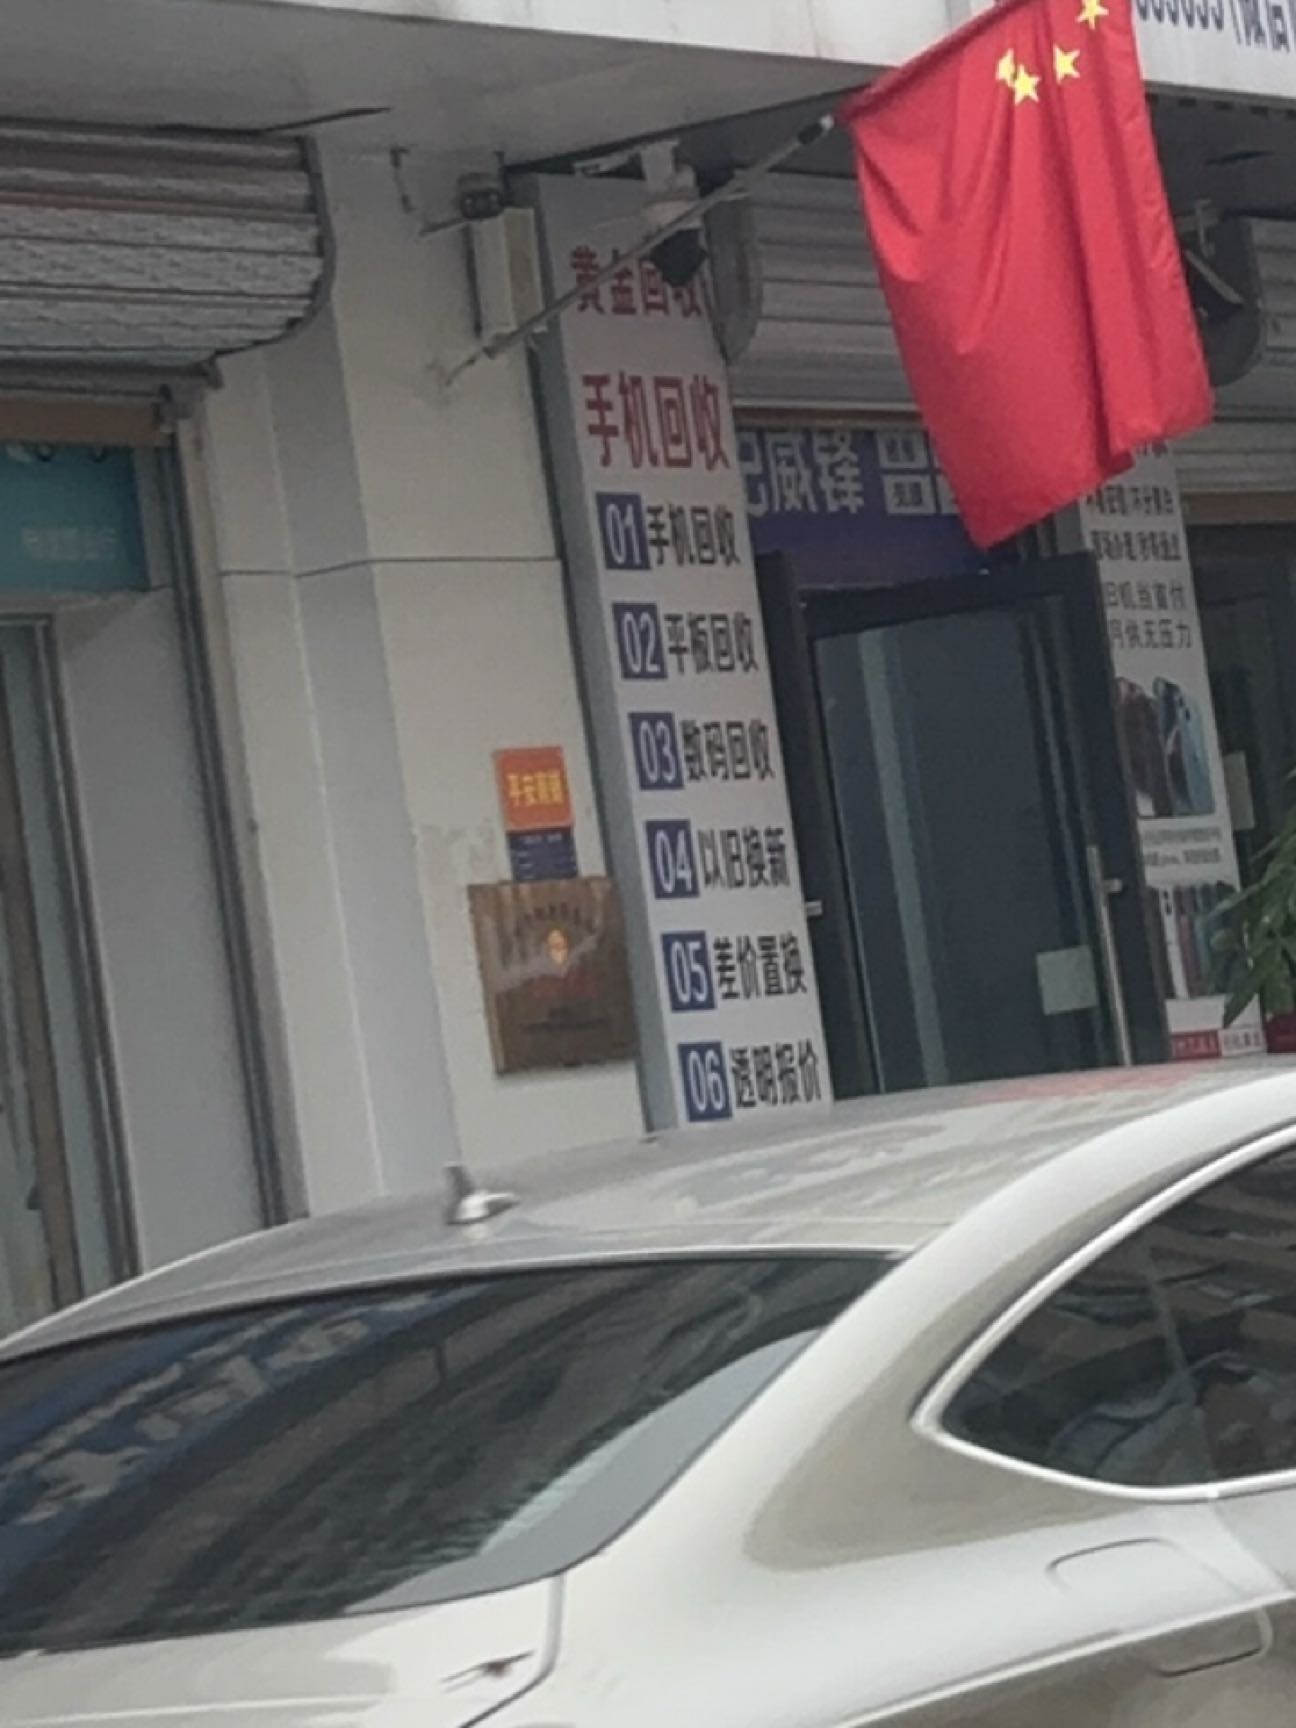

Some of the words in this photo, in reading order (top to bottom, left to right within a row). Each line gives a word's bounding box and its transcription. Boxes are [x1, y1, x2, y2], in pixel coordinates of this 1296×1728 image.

[581, 369, 731, 472] 手机回收
[605, 502, 643, 566] 01
[647, 500, 742, 568] 手机回收
[622, 611, 662, 674] 02
[663, 610, 760, 675] 平板回收
[638, 719, 677, 784] 03
[679, 717, 777, 782] 数码回收
[653, 828, 694, 895] 04
[697, 825, 791, 892] 以旧换新
[668, 939, 710, 1004] 05
[712, 930, 808, 1002] 差价置换
[686, 1049, 727, 1112] 06
[729, 1038, 823, 1109] 透明报价
